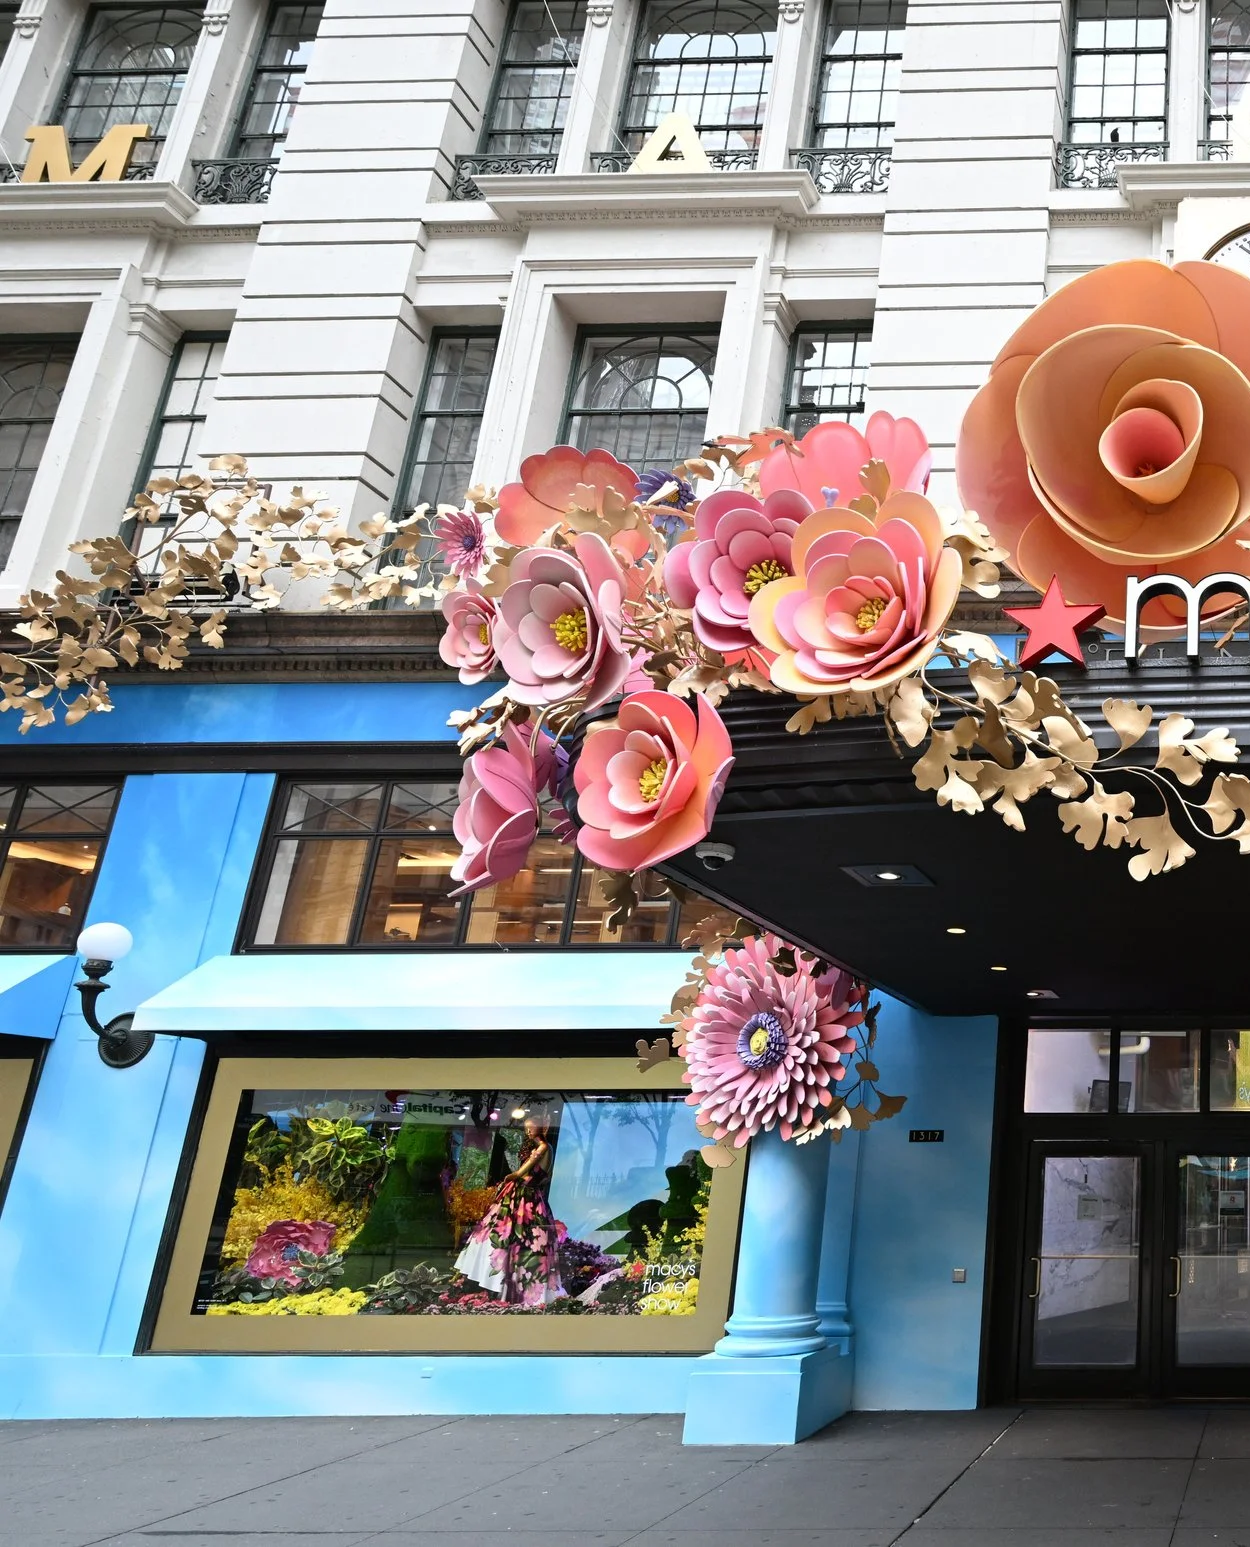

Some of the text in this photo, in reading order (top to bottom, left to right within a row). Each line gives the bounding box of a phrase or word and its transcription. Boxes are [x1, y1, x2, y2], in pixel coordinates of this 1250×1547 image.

[21, 124, 152, 182] M
[627, 111, 713, 172] A
[913, 1131, 940, 1140] 1317
[642, 1279, 690, 1293] flower
[639, 1296, 682, 1310] show
